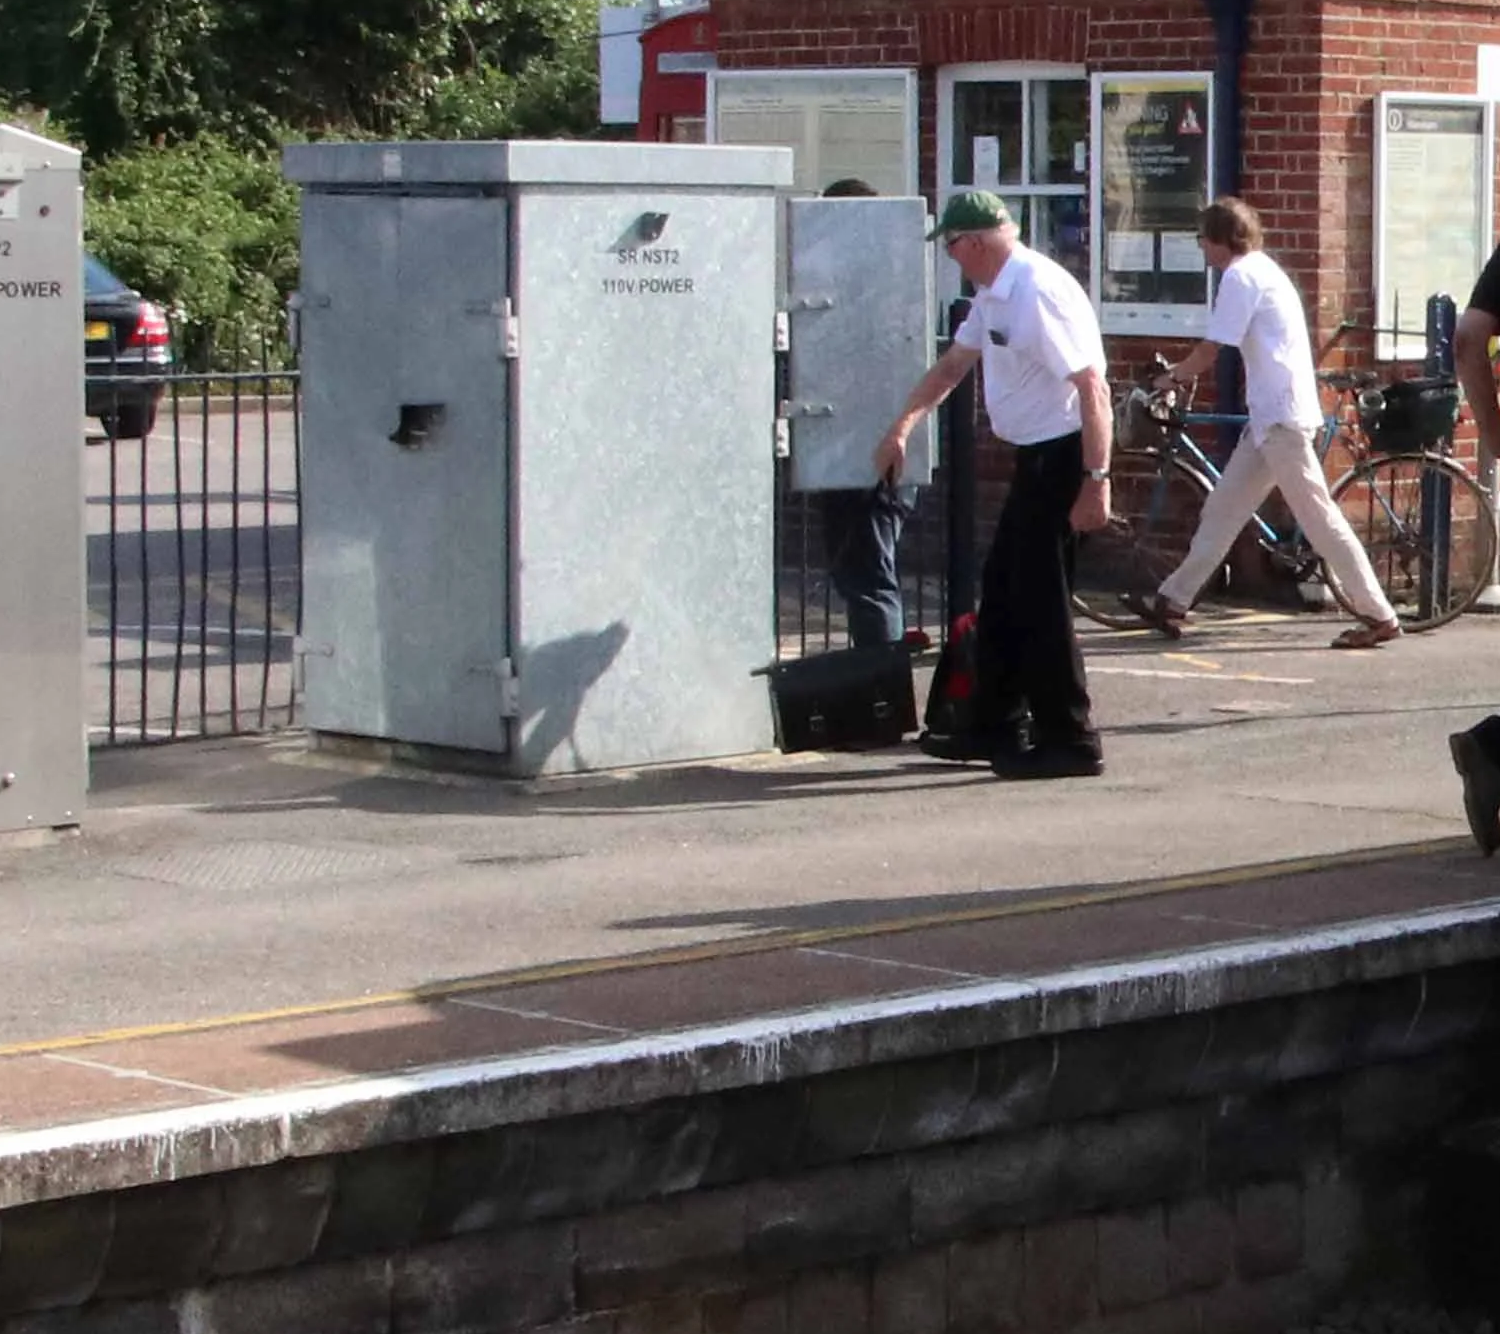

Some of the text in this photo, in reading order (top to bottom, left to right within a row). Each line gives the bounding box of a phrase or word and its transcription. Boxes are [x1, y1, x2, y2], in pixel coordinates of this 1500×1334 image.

[618, 249, 680, 265] SR NST2
[602, 277, 694, 294] 110V POWER
